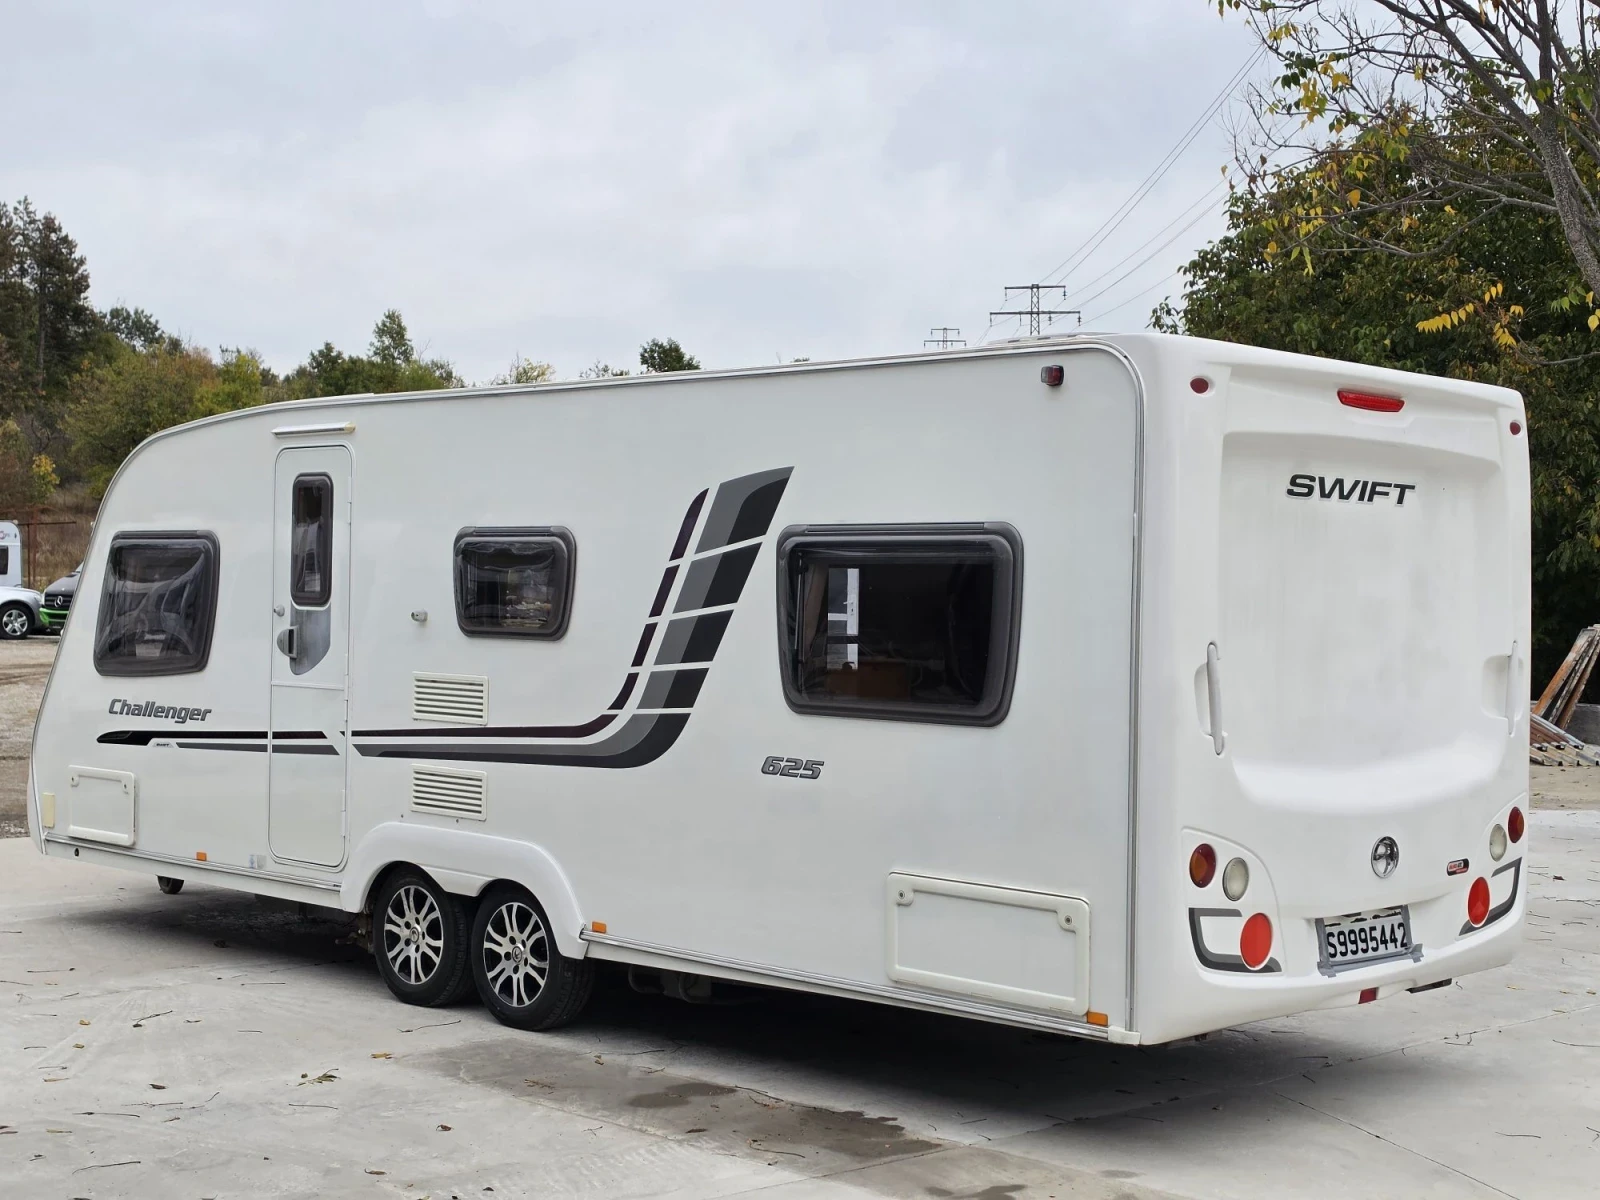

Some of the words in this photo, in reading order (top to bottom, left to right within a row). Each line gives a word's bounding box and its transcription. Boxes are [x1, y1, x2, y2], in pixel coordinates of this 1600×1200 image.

[1286, 473, 1416, 505] SWIFT
[108, 698, 212, 724] Challenger
[761, 755, 825, 779] 625
[1326, 922, 1408, 958] S9995442
